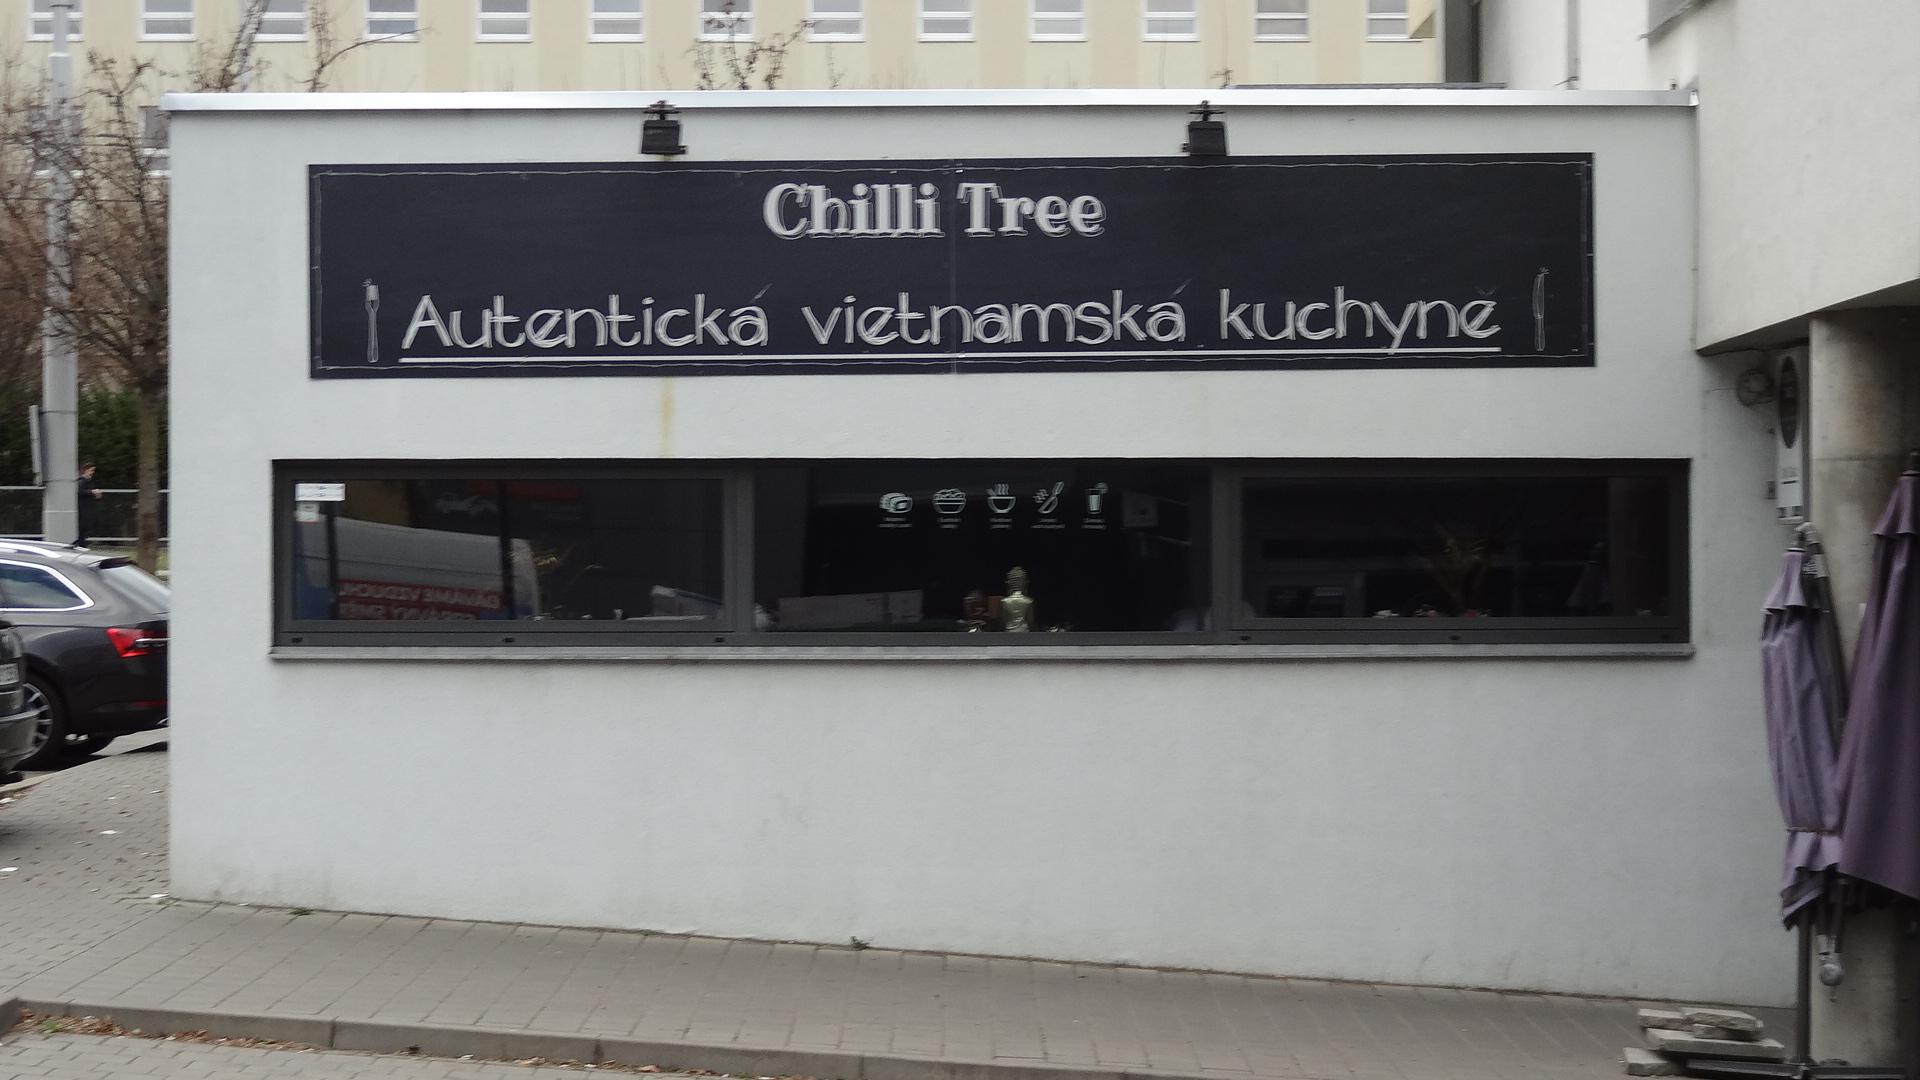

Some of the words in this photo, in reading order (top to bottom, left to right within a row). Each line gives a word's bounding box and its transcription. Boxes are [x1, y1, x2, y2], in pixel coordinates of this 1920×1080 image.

[763, 183, 945, 239] Chilli
[956, 182, 1106, 237] Tree
[402, 284, 772, 349] Autentická
[800, 279, 1192, 345] vietnamská
[1218, 285, 1501, 355] kuchyně
